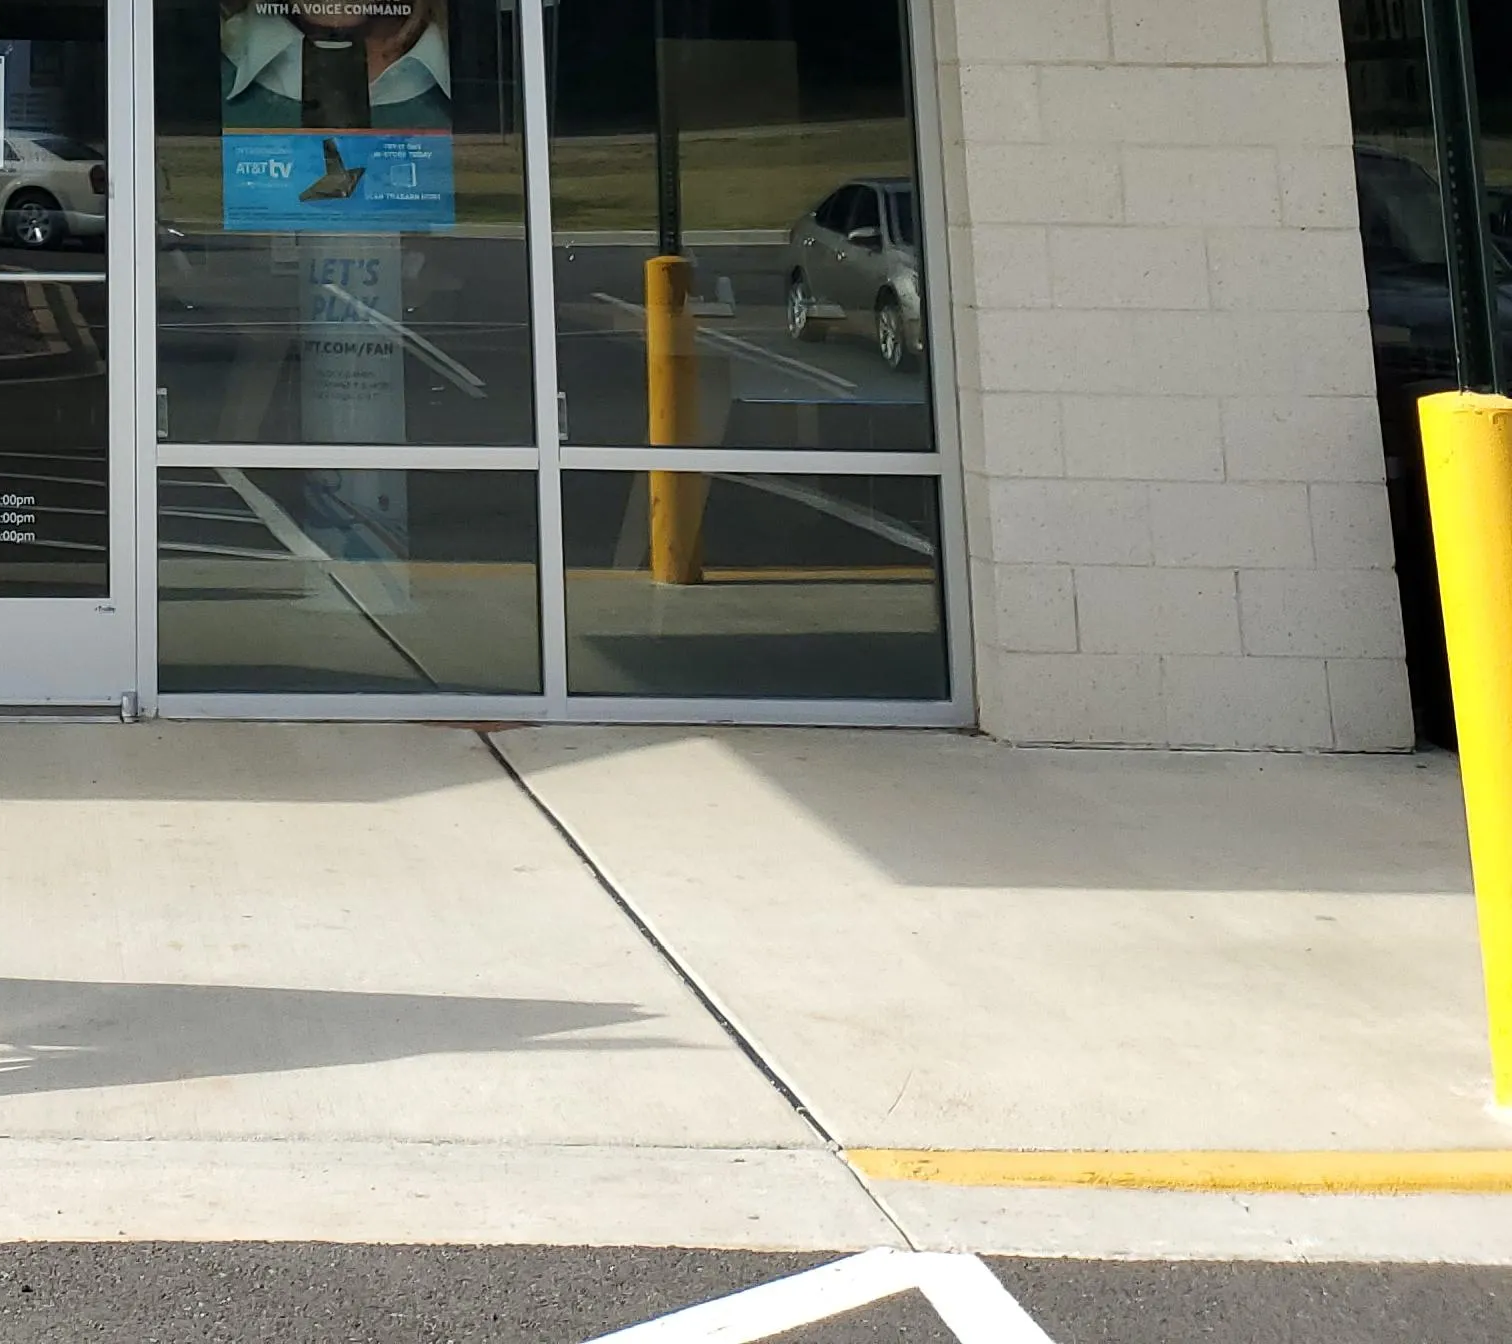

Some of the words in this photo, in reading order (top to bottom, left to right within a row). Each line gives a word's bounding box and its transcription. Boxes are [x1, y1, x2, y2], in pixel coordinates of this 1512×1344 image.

[256, 3, 289, 15] WITH
[291, 3, 301, 15] A
[304, 3, 342, 15] VOICE
[344, 4, 412, 16] COMMAND
[236, 161, 268, 176] AT&T
[268, 159, 293, 178] tv
[309, 258, 380, 286] LET'S
